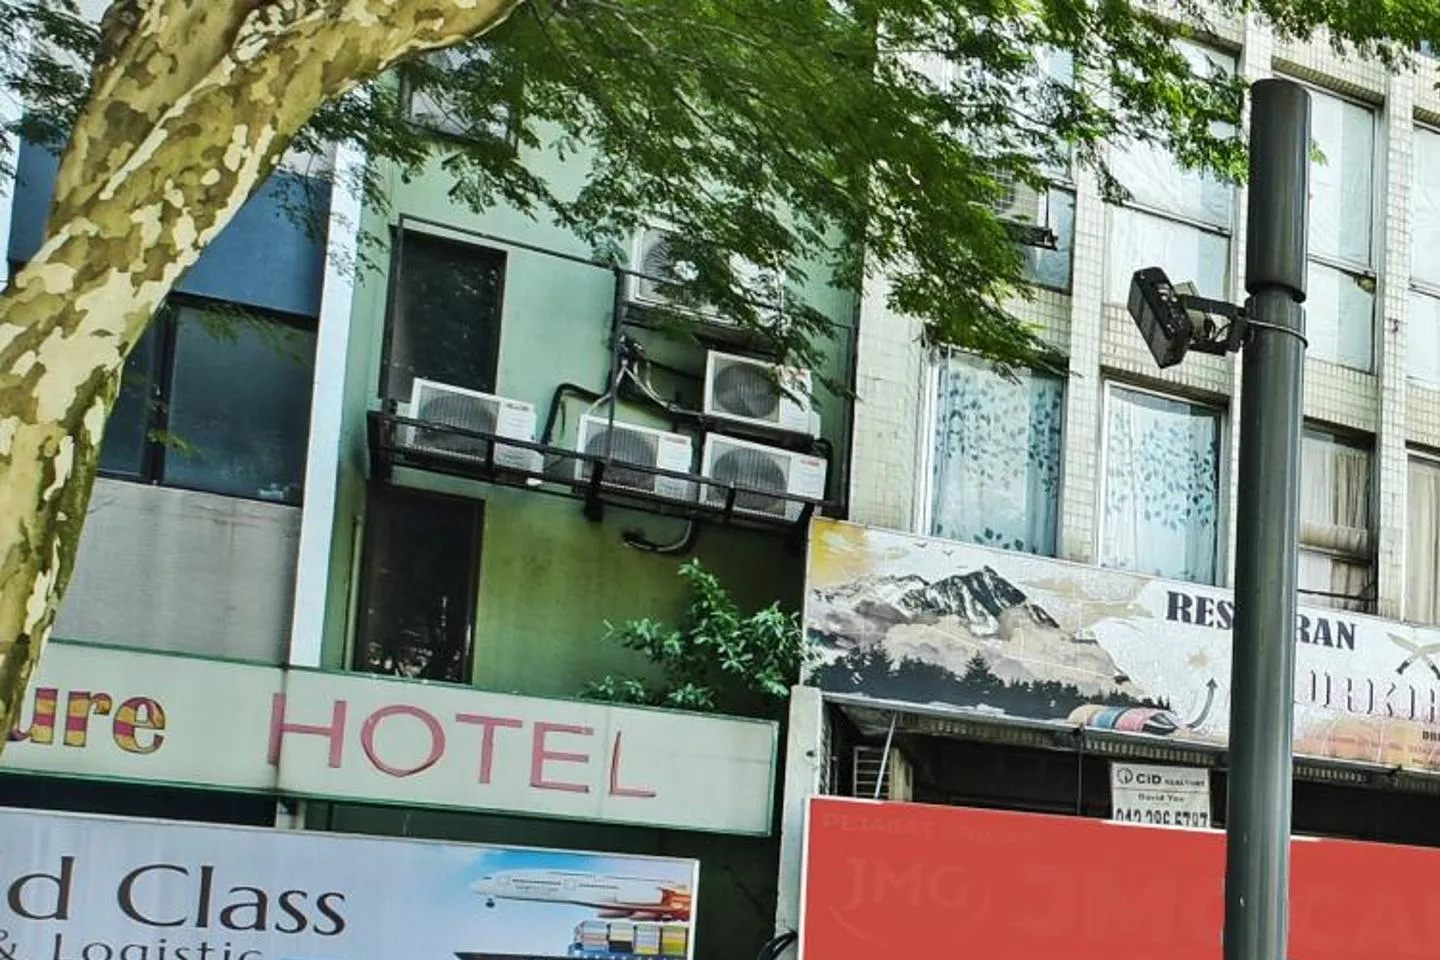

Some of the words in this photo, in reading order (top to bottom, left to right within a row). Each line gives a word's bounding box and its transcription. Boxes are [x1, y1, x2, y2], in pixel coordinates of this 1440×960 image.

[1166, 591, 1357, 651] RESRAN
[8, 687, 166, 754] ure
[268, 693, 656, 797] HOTEL
[7, 856, 75, 921] d
[117, 863, 347, 936] Class
